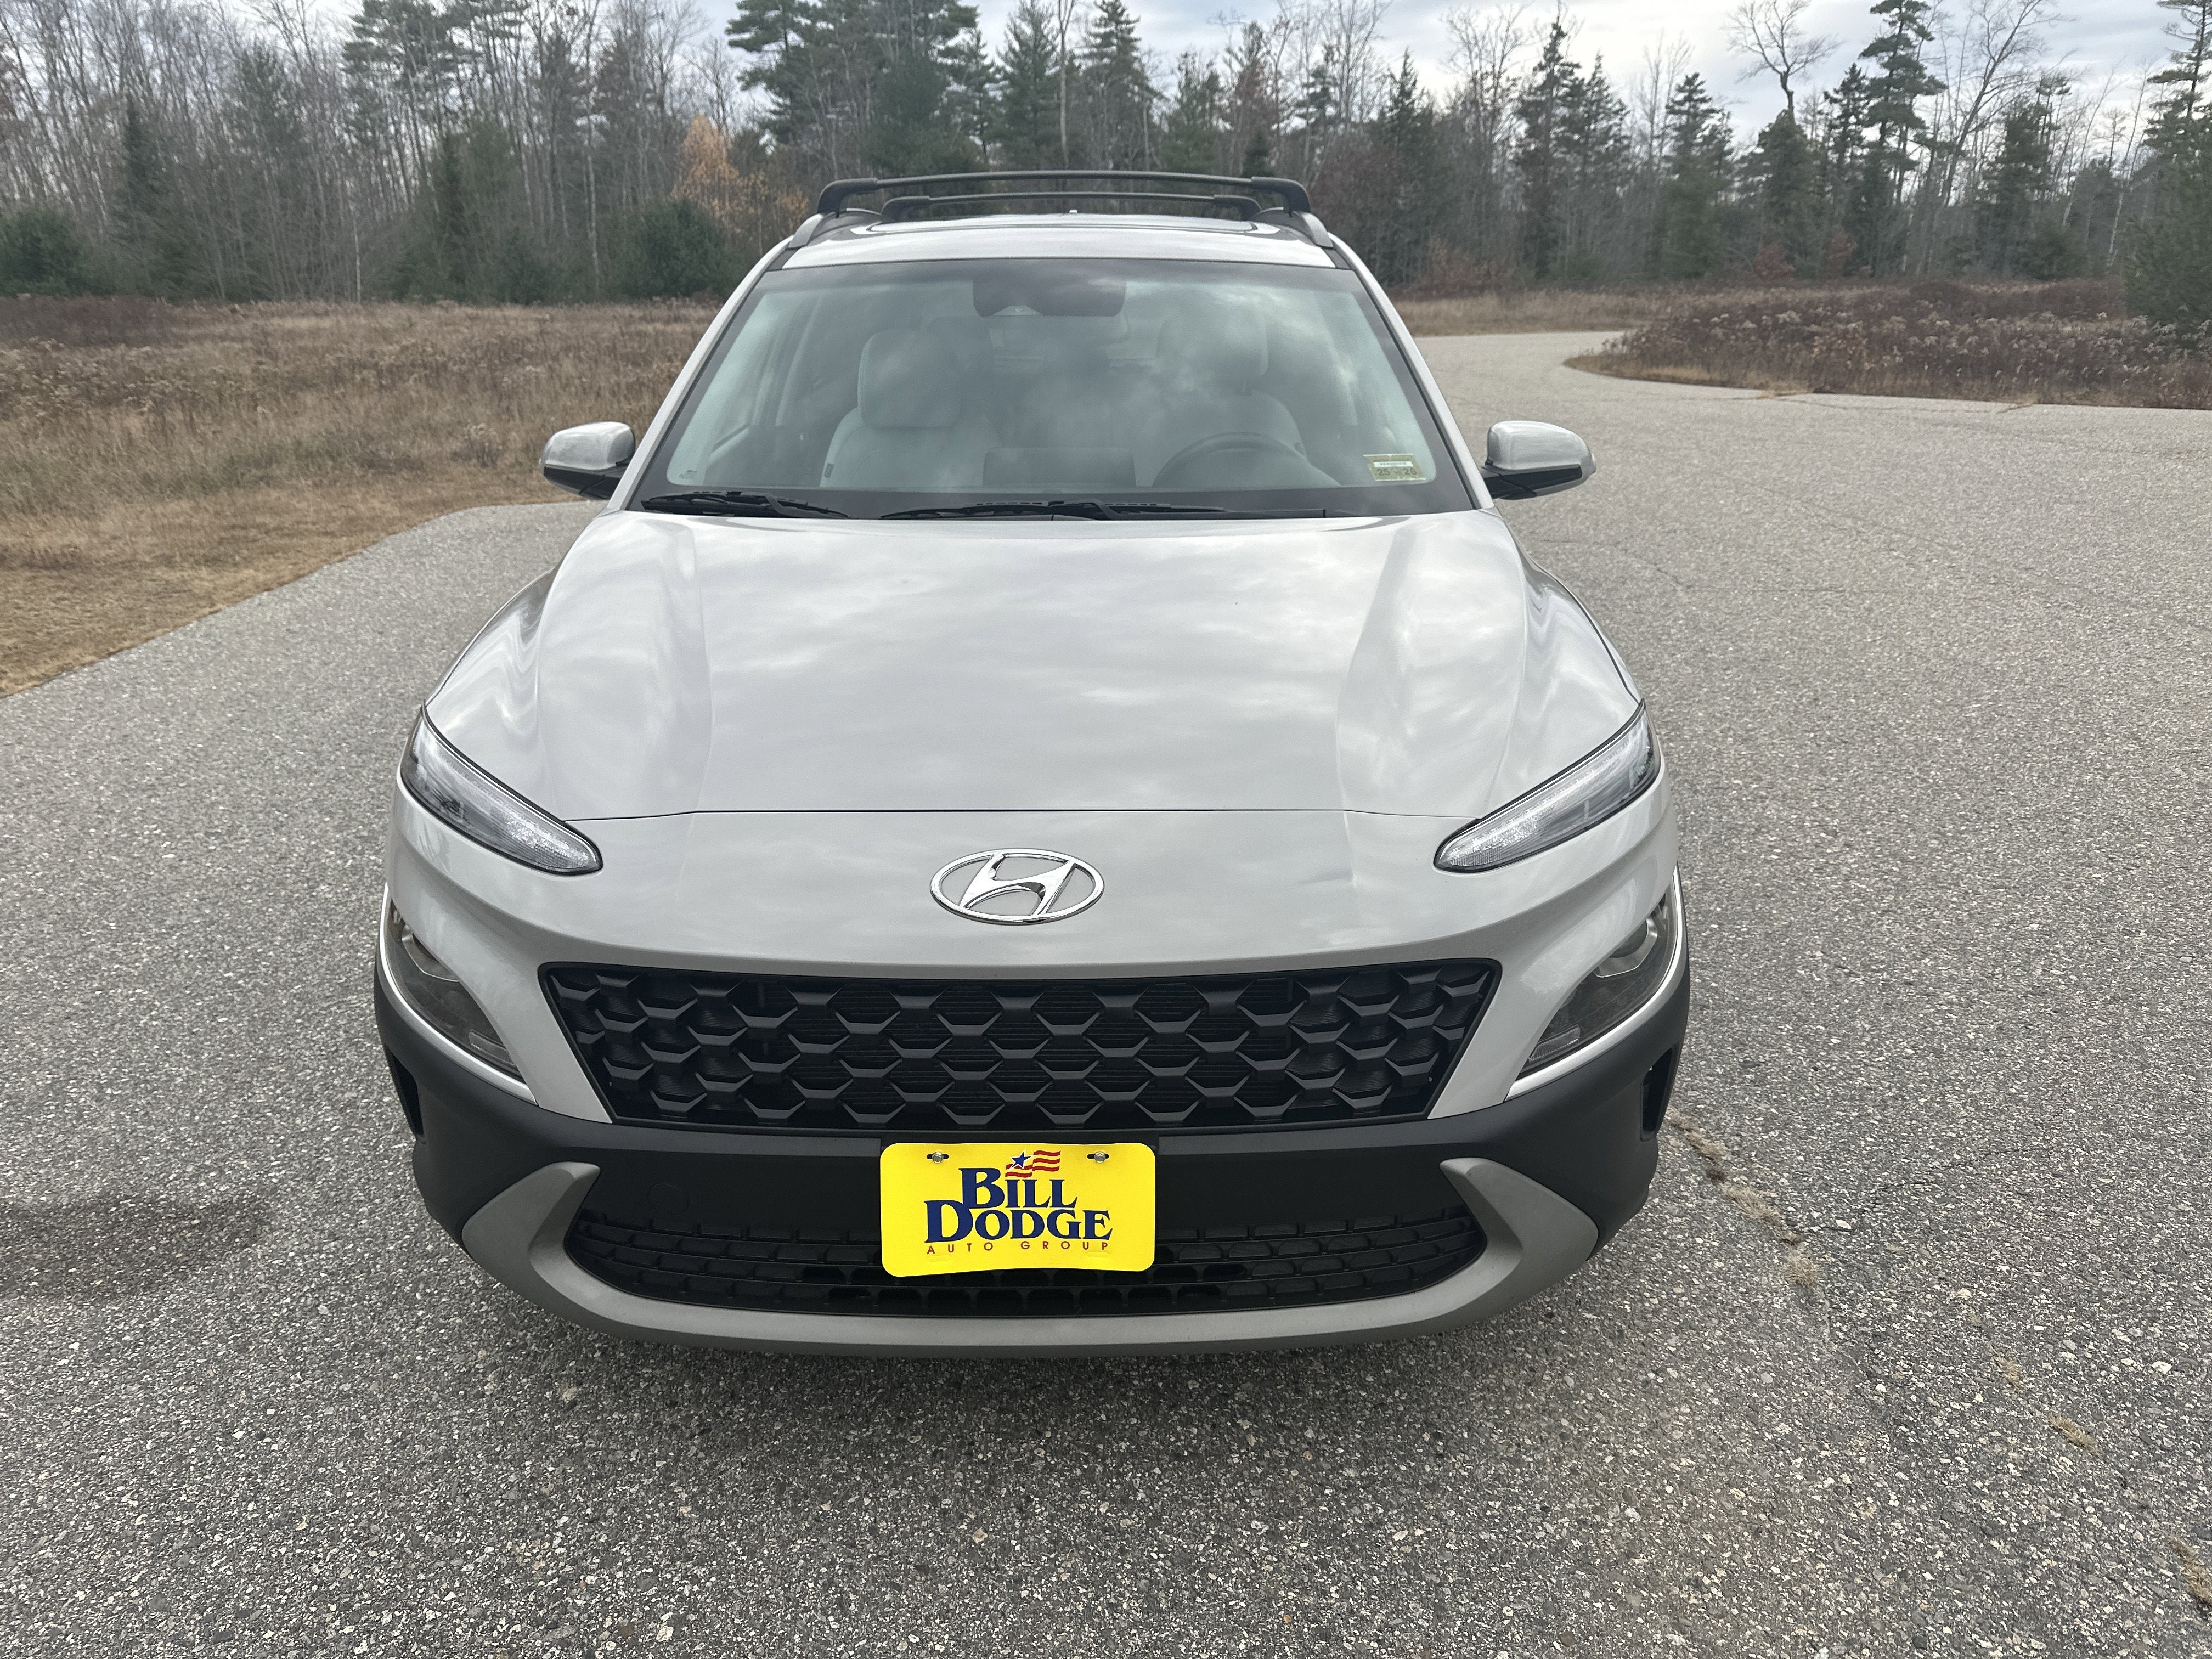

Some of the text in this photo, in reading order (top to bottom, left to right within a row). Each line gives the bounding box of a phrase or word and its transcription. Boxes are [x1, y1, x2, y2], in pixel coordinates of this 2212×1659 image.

[958, 1167, 1078, 1209] BILL
[924, 1200, 1113, 1243] DODGE
[926, 1240, 1109, 1255] AUTO GROUP
